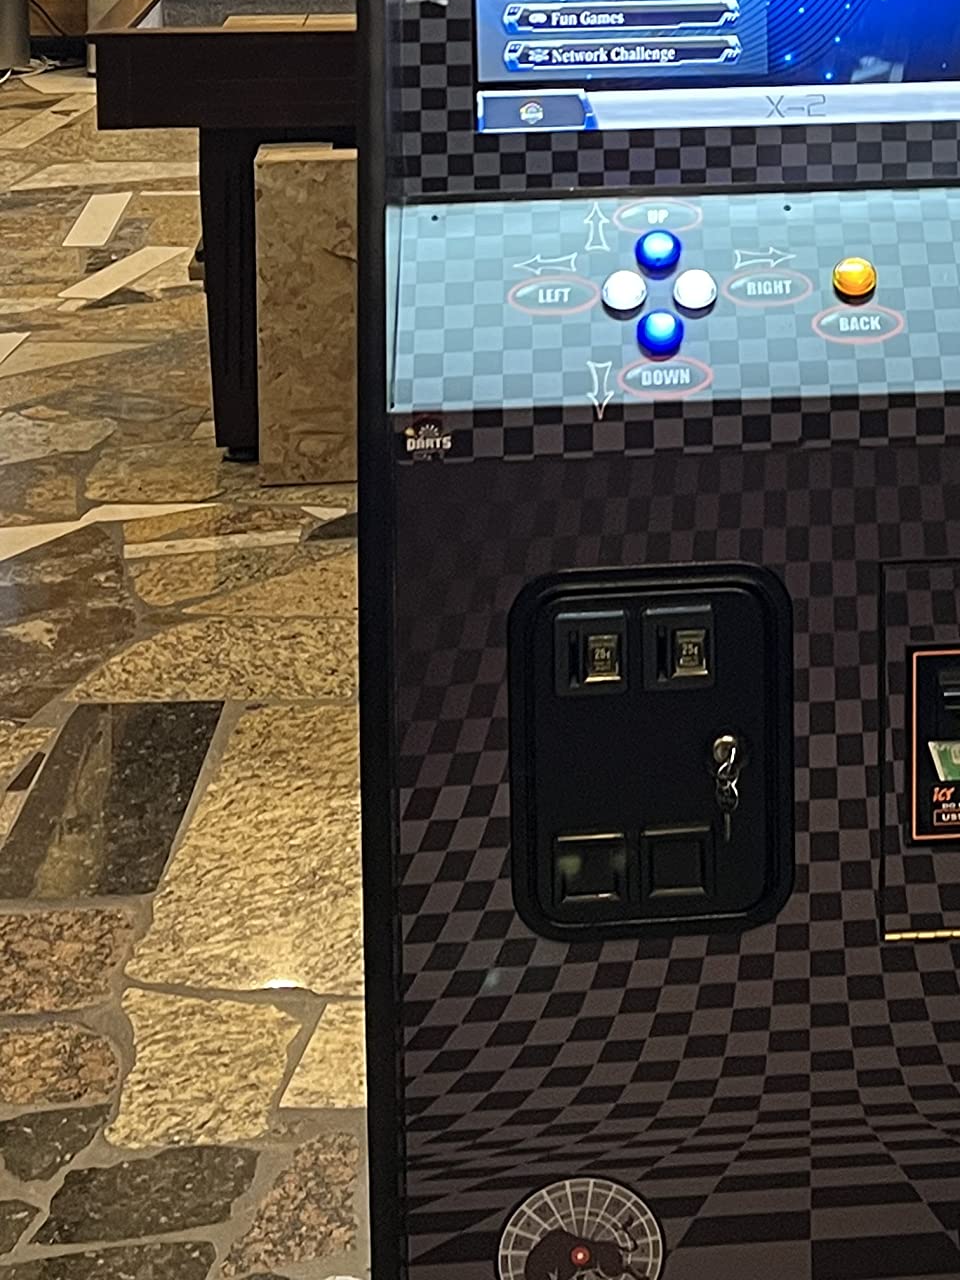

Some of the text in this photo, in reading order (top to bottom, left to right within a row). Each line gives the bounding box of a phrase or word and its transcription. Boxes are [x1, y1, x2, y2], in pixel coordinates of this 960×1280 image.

[551, 11, 624, 26] Fun Games
[551, 45, 676, 63] Network Challenge
[647, 209, 669, 224] UP
[537, 287, 571, 303] LEFT
[746, 279, 792, 296] RIGHT
[839, 315, 881, 332] BACK
[641, 368, 691, 387] DOWN
[406, 435, 451, 452] DARTS
[941, 802, 957, 810] DO
